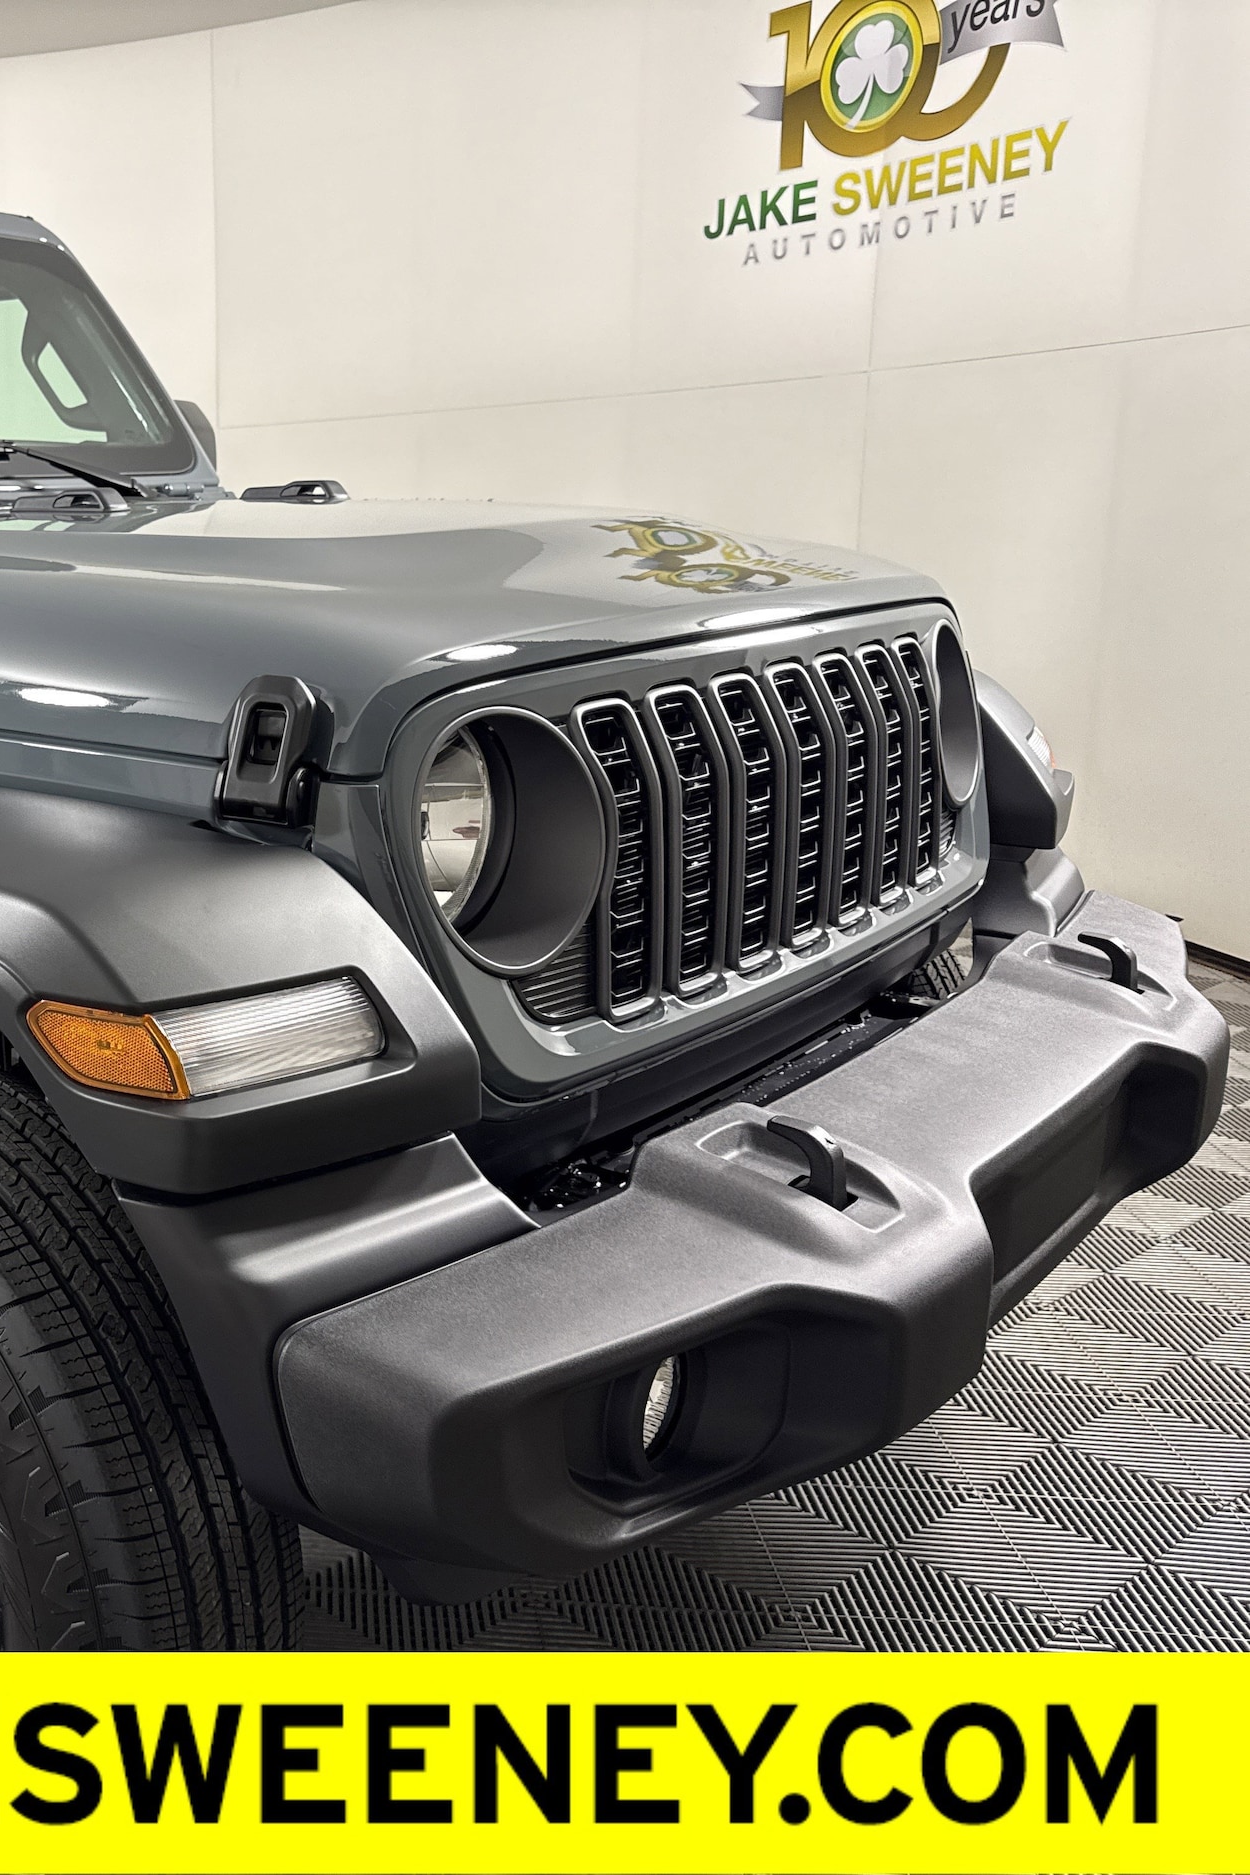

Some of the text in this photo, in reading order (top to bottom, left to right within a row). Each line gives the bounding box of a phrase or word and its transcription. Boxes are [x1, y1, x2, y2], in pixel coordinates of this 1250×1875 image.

[703, 119, 1070, 240] JAKE SWEENEY
[742, 193, 1017, 266] AUTOMOTIVE
